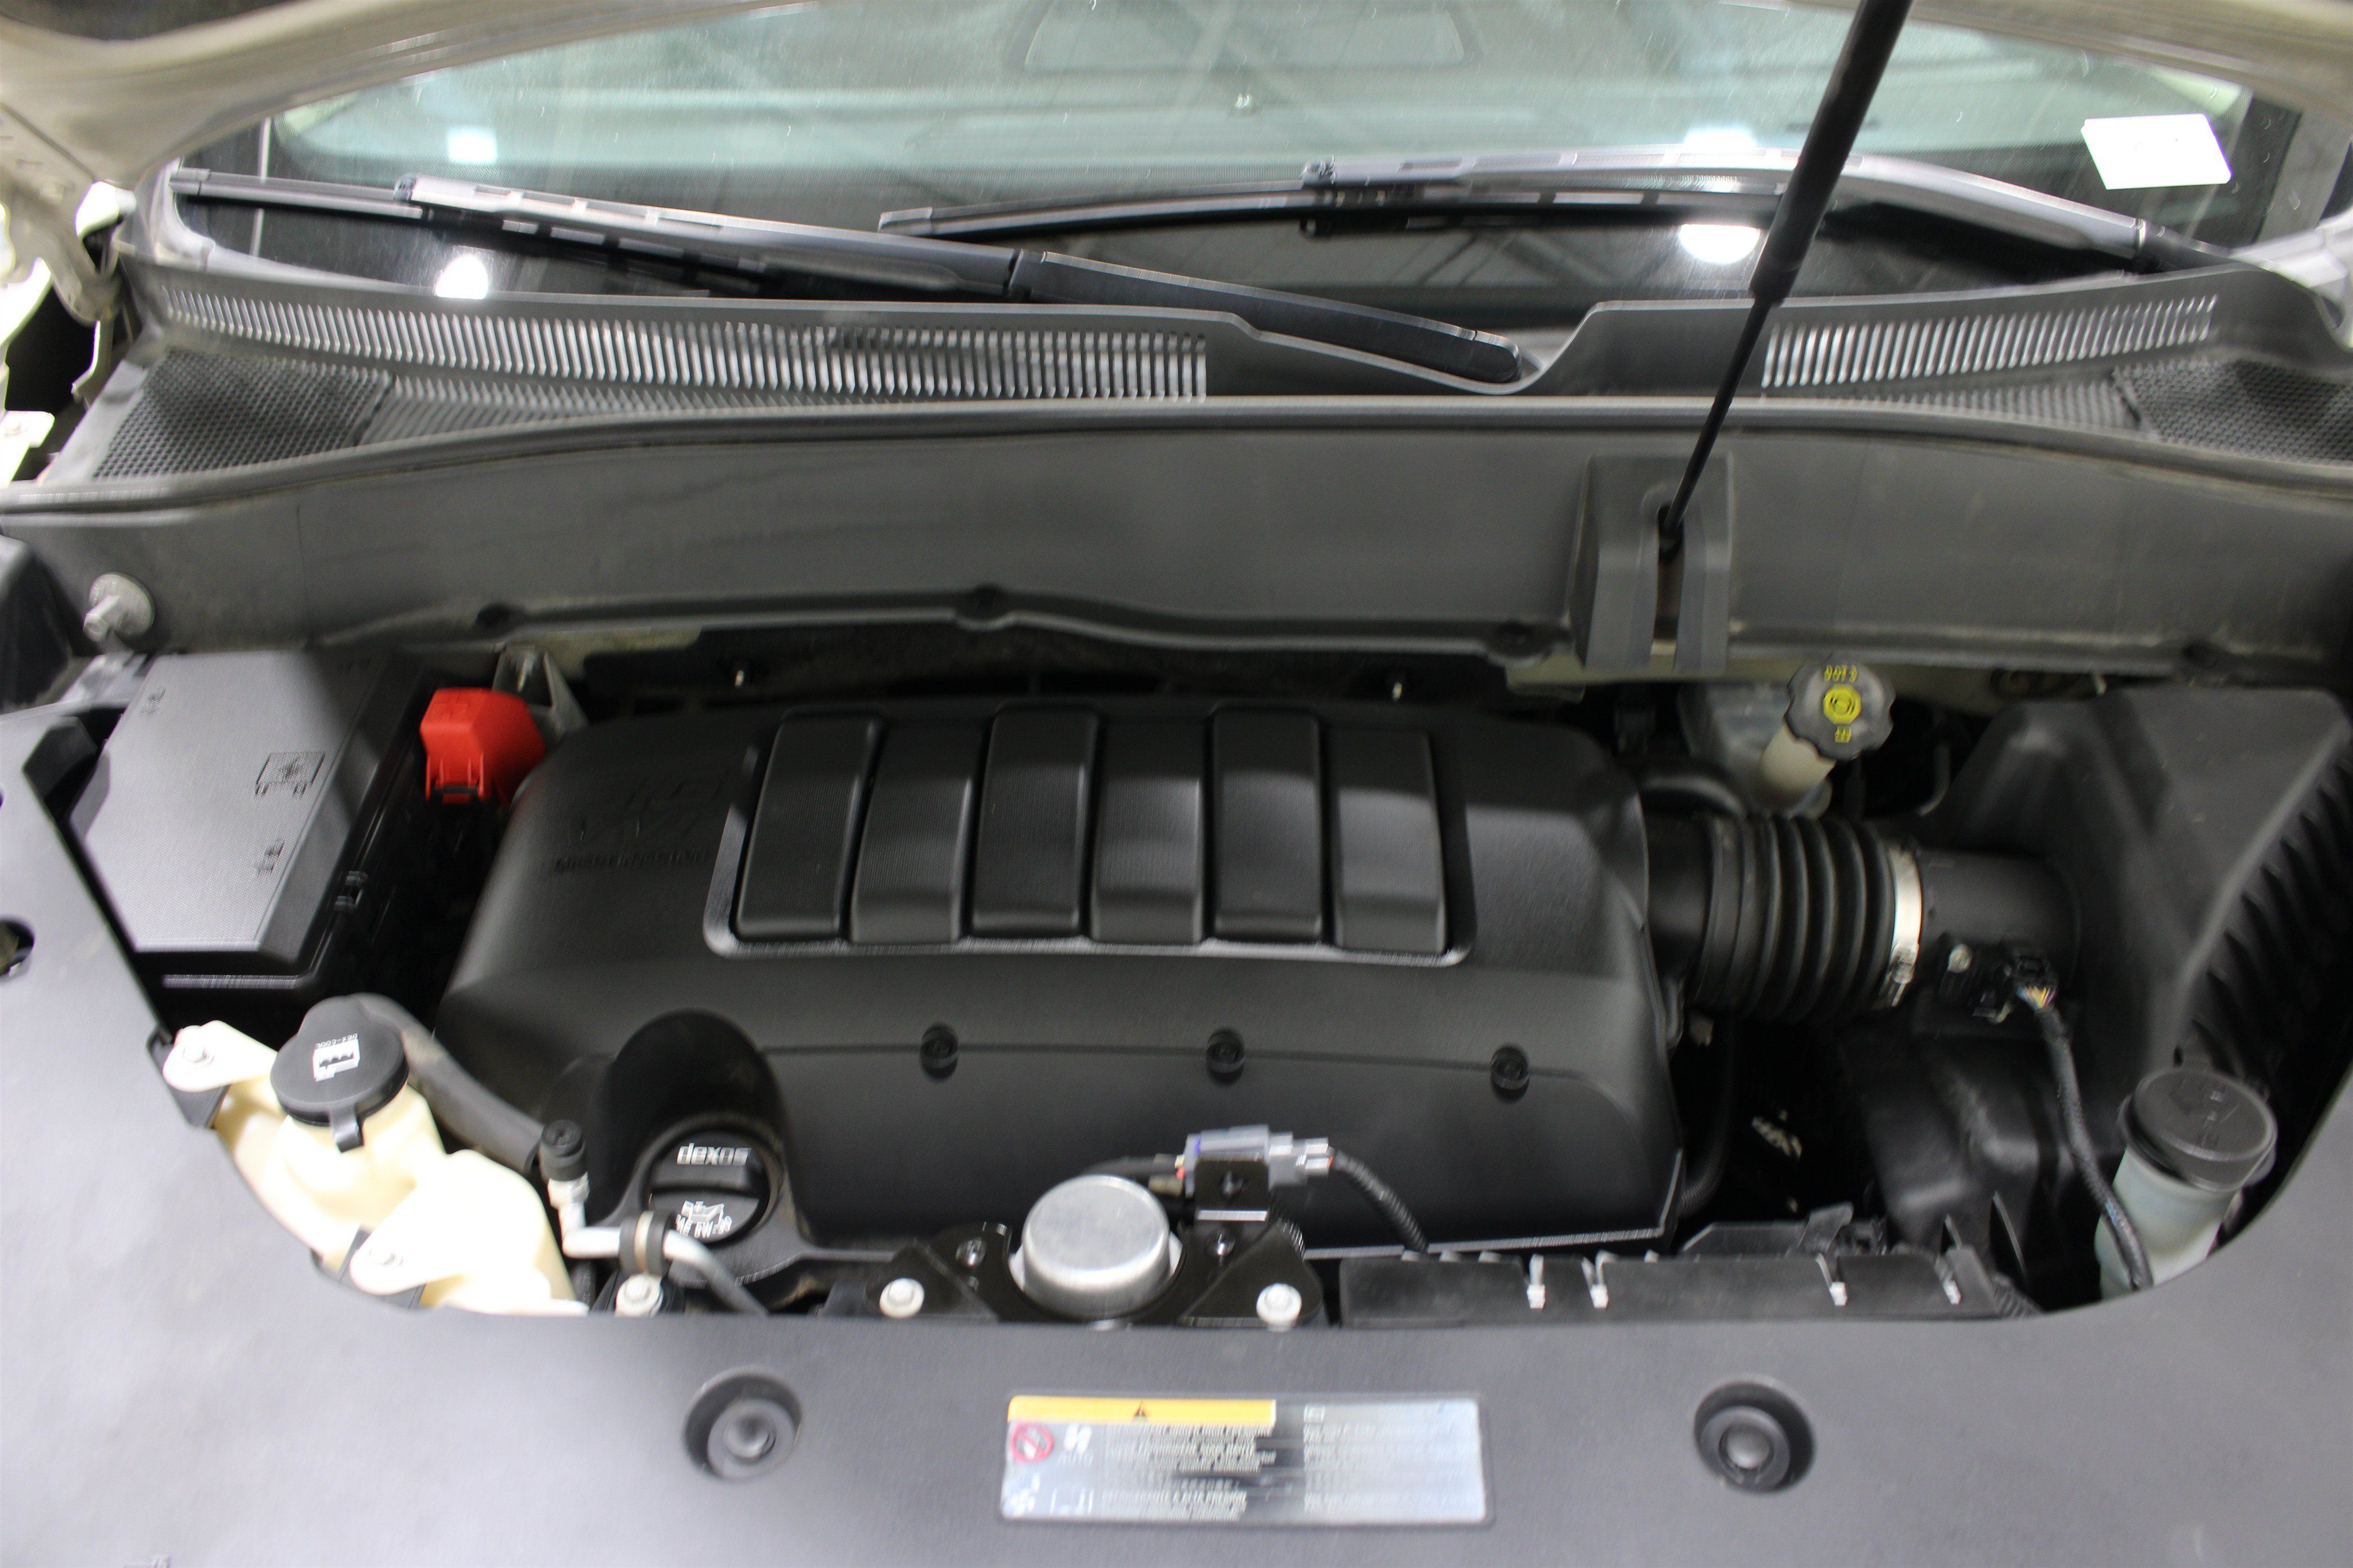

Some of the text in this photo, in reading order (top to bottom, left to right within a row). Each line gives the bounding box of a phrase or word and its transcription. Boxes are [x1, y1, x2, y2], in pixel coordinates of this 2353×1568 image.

[1824, 665, 1847, 682] DOT
[315, 1033, 358, 1049] DEX-COOL
[676, 1142, 751, 1165] dexos
